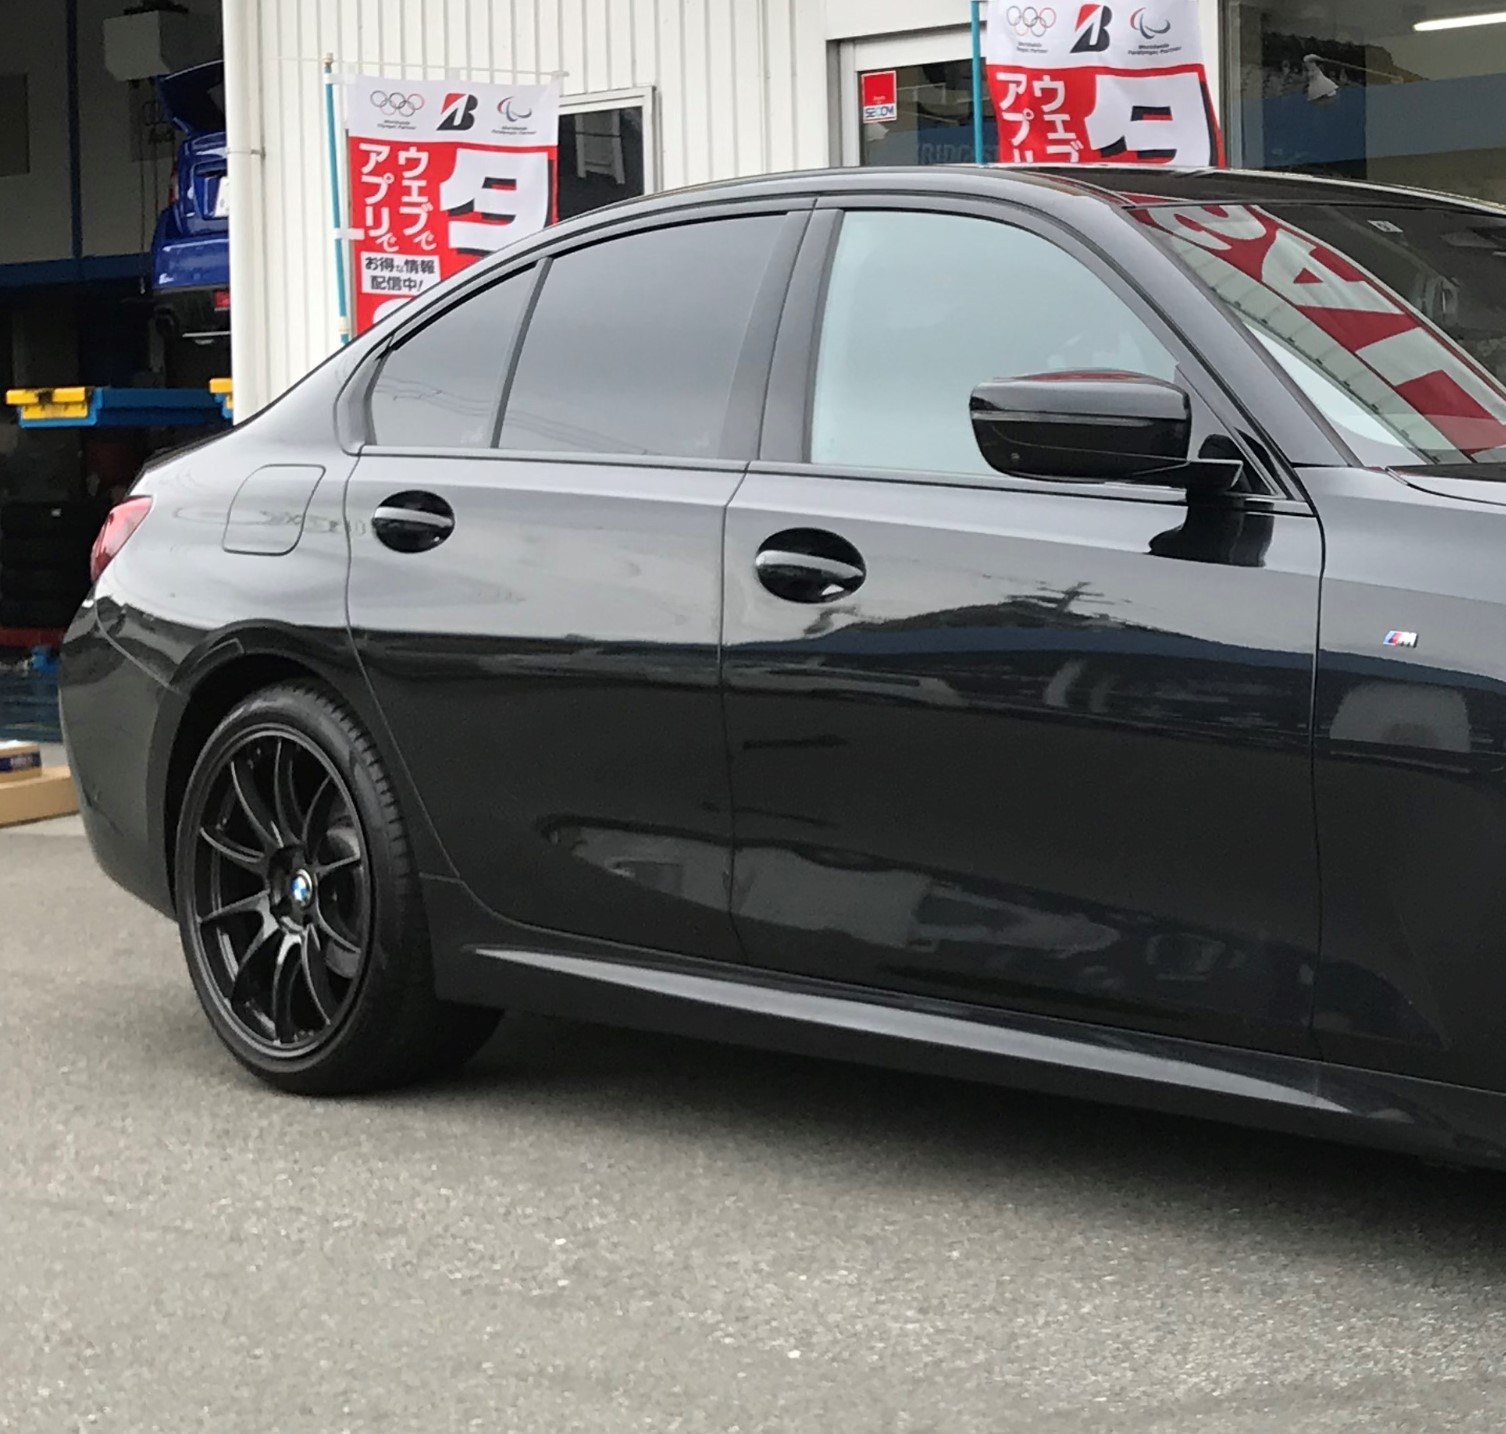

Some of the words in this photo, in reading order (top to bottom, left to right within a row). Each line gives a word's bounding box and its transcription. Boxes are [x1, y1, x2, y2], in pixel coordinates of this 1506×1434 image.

[359, 143, 399, 252] アプリで
[364, 256, 435, 275] お得な情報
